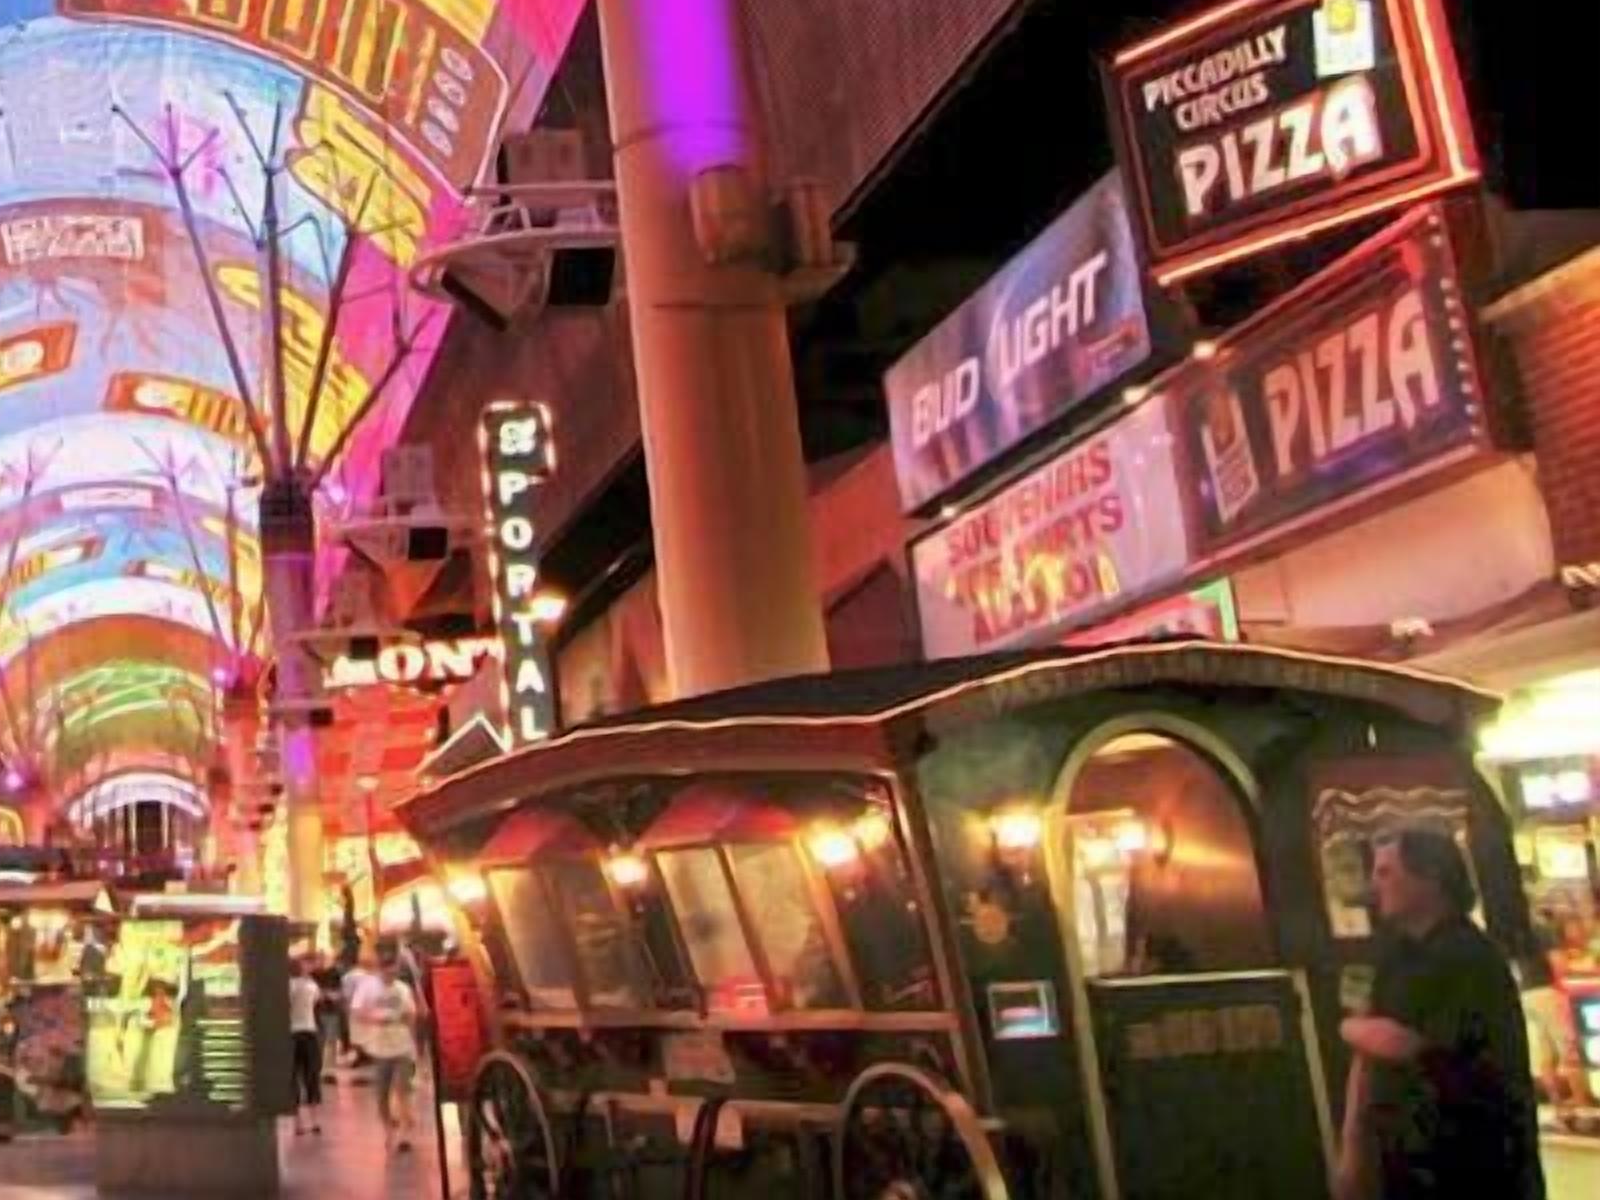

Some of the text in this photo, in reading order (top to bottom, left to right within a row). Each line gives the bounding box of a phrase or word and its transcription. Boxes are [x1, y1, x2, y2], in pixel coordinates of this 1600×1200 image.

[1142, 25, 1288, 113] PICCADILLY
[1175, 73, 1270, 131] CIRCUS
[1179, 74, 1384, 217] PIZZA
[912, 355, 981, 449] BUD
[1262, 286, 1441, 478] PIZZA
